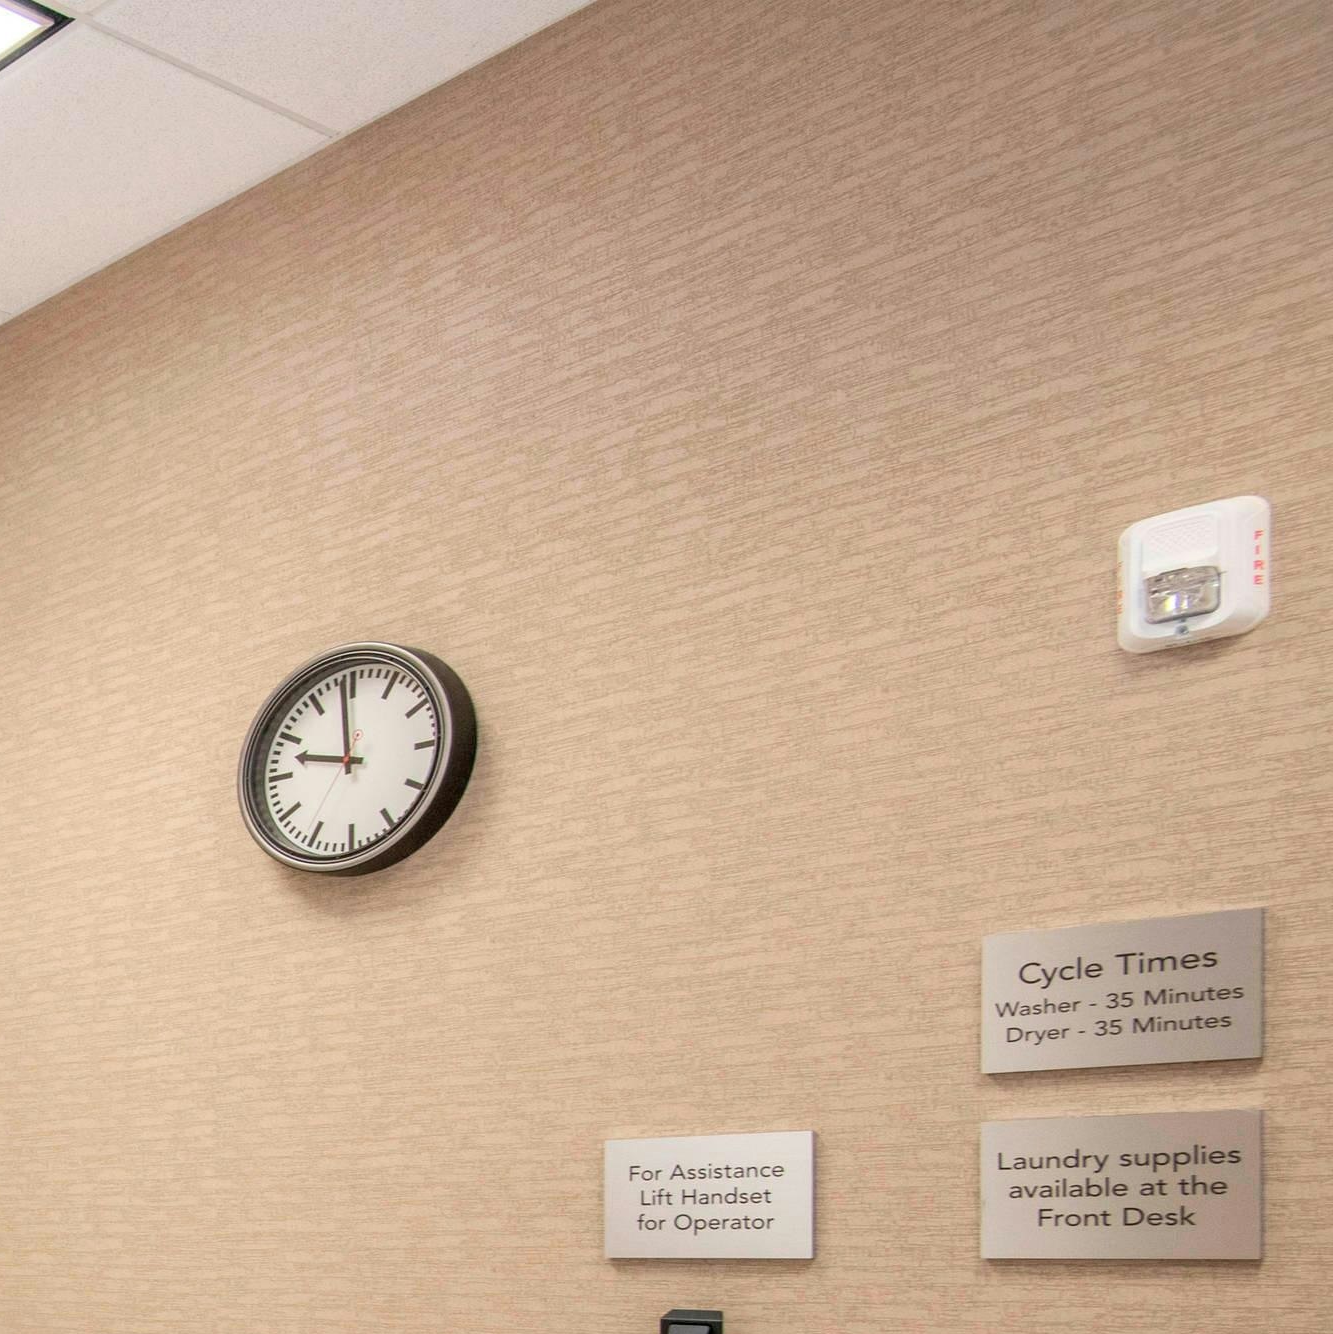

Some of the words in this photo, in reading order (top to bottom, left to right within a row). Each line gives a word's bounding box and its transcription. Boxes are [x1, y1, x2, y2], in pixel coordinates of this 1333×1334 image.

[1253, 530, 1265, 585] FIRE
[1019, 957, 1103, 989] Cycle
[1115, 951, 1218, 975] Times
[995, 998, 1081, 1018] Washer
[1106, 991, 1134, 1009] 35
[1144, 986, 1245, 1006] Minutes
[1006, 1026, 1070, 1046] Dryer
[1094, 1019, 1123, 1036] 35
[1132, 1014, 1232, 1034] Minutes
[997, 1149, 1109, 1173] Laundry
[1119, 1144, 1242, 1173] supplies
[629, 1165, 663, 1182] For
[669, 1163, 785, 1181] Assistance
[640, 1188, 673, 1206] Lift
[682, 1187, 772, 1205] Handset
[1009, 1177, 1129, 1199] available
[1139, 1179, 1168, 1196] at
[1177, 1175, 1229, 1196] the
[637, 1213, 666, 1231] for
[674, 1213, 775, 1235] Operator
[1038, 1208, 1112, 1227] Front
[1122, 1205, 1196, 1226] Desk
